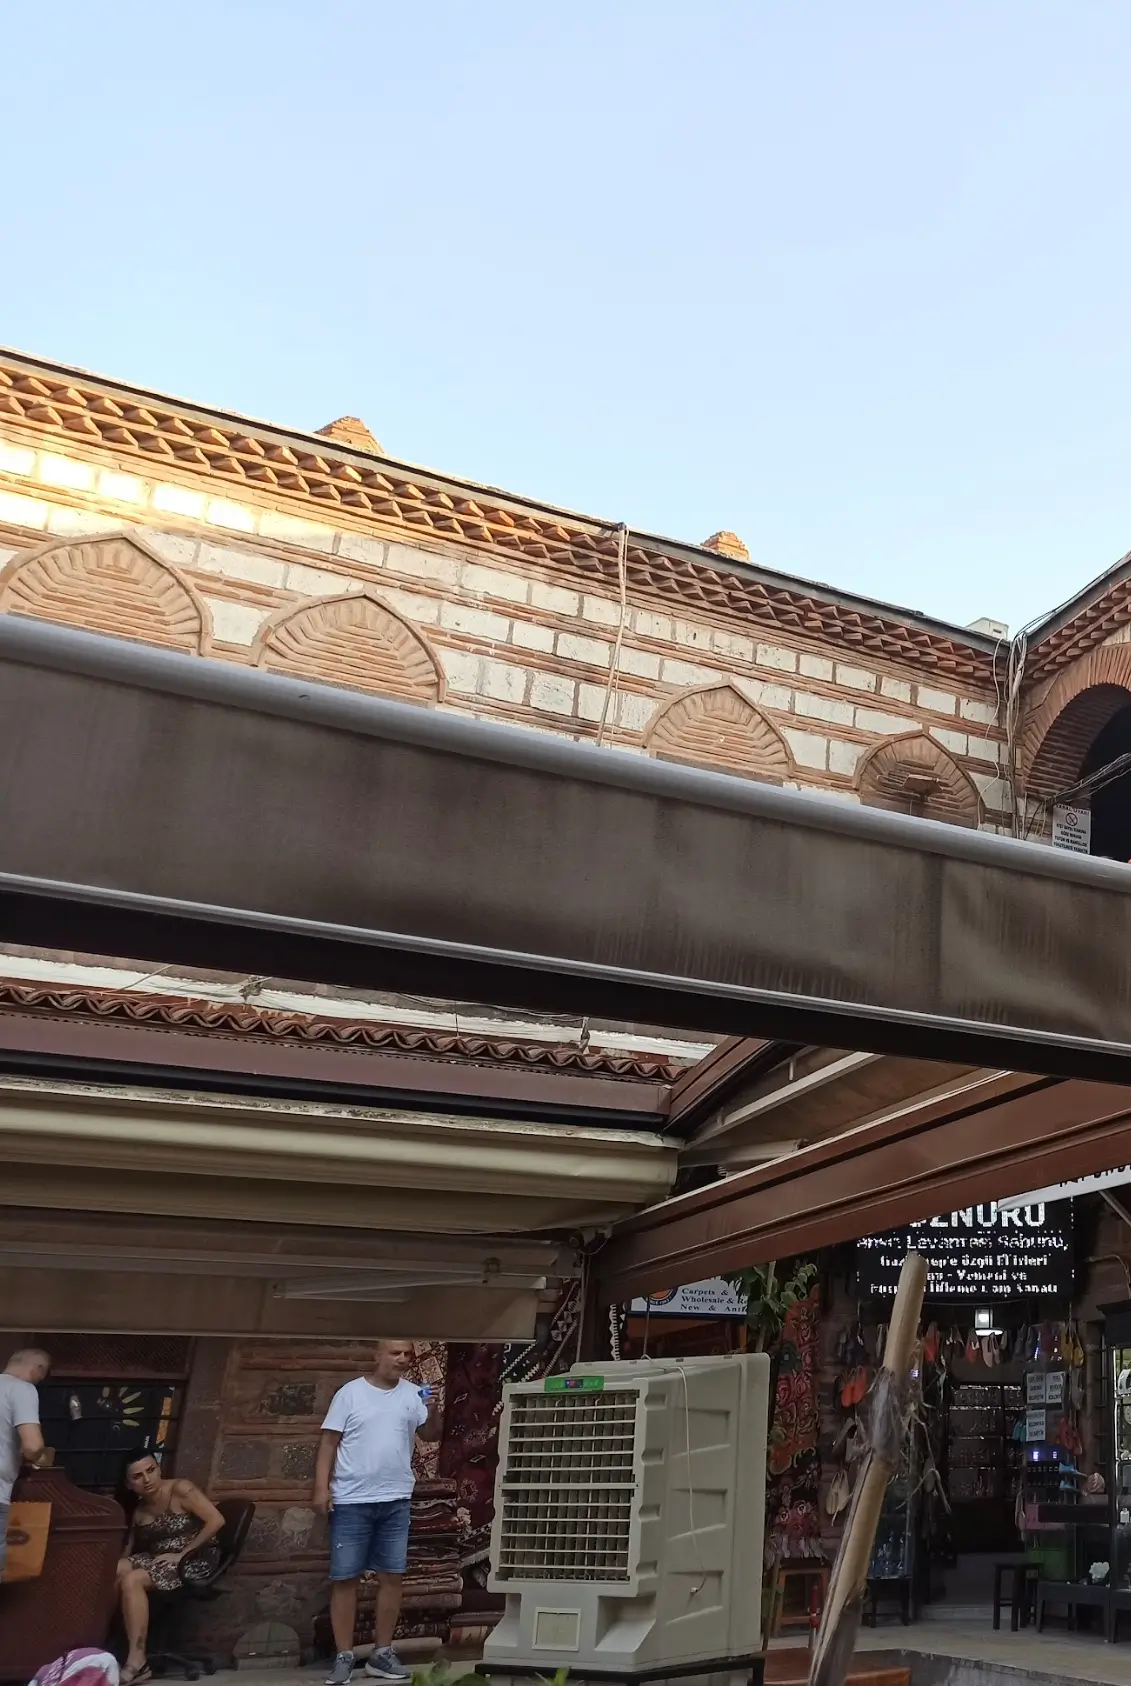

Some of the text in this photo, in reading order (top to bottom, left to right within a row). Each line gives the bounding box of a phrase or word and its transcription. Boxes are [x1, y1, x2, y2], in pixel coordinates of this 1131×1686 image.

[681, 1288, 716, 1297] Carpets
[681, 1296, 725, 1304] Wholesale
[680, 1303, 700, 1311] New
